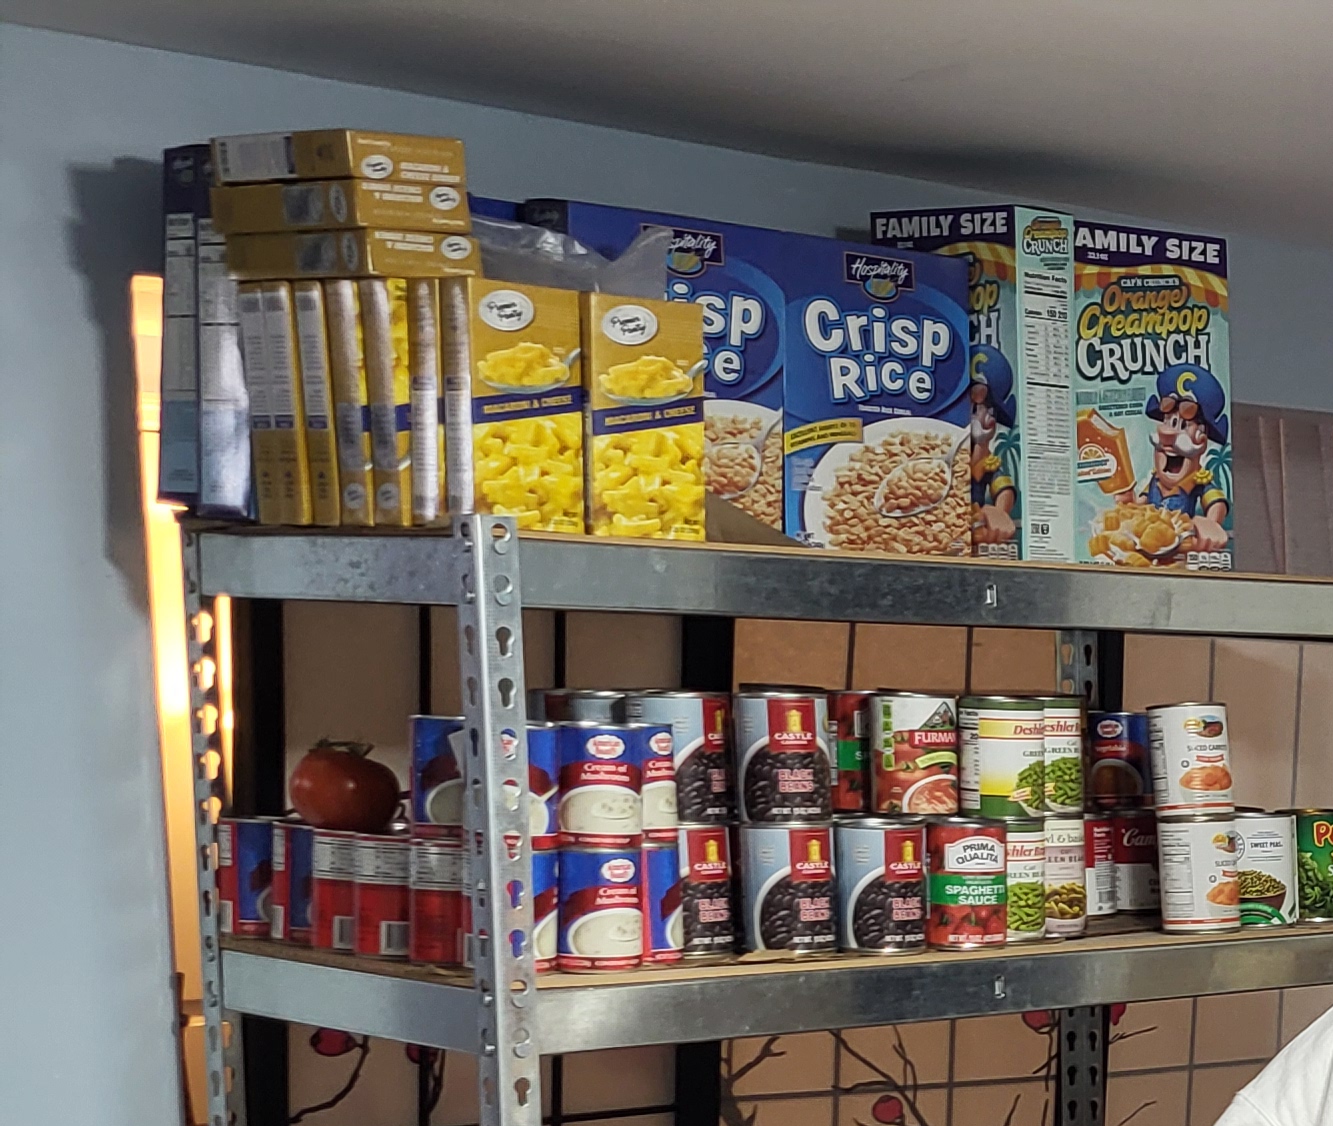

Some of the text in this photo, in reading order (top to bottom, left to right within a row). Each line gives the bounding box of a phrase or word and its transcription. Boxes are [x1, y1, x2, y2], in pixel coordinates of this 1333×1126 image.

[875, 215, 954, 239] FAMILY
[959, 211, 1008, 235] SIZE
[1022, 238, 1069, 254] CRUNCH
[1073, 227, 1159, 256] AMILY
[1165, 237, 1221, 264] SIZE
[851, 258, 911, 284] Hospitality
[1103, 284, 1188, 313] Orange
[804, 299, 951, 368] Crisp
[1078, 304, 1209, 341] Creampop
[1076, 333, 1210, 381] CRUNCH
[828, 353, 933, 400] Rice
[773, 732, 814, 741] CASTLE
[1013, 724, 1044, 736] Deshl
[1044, 720, 1073, 733] eshler
[962, 842, 996, 854] PRIMA
[945, 884, 1006, 896] SPAGHETTI
[957, 895, 999, 905] SAUCE
